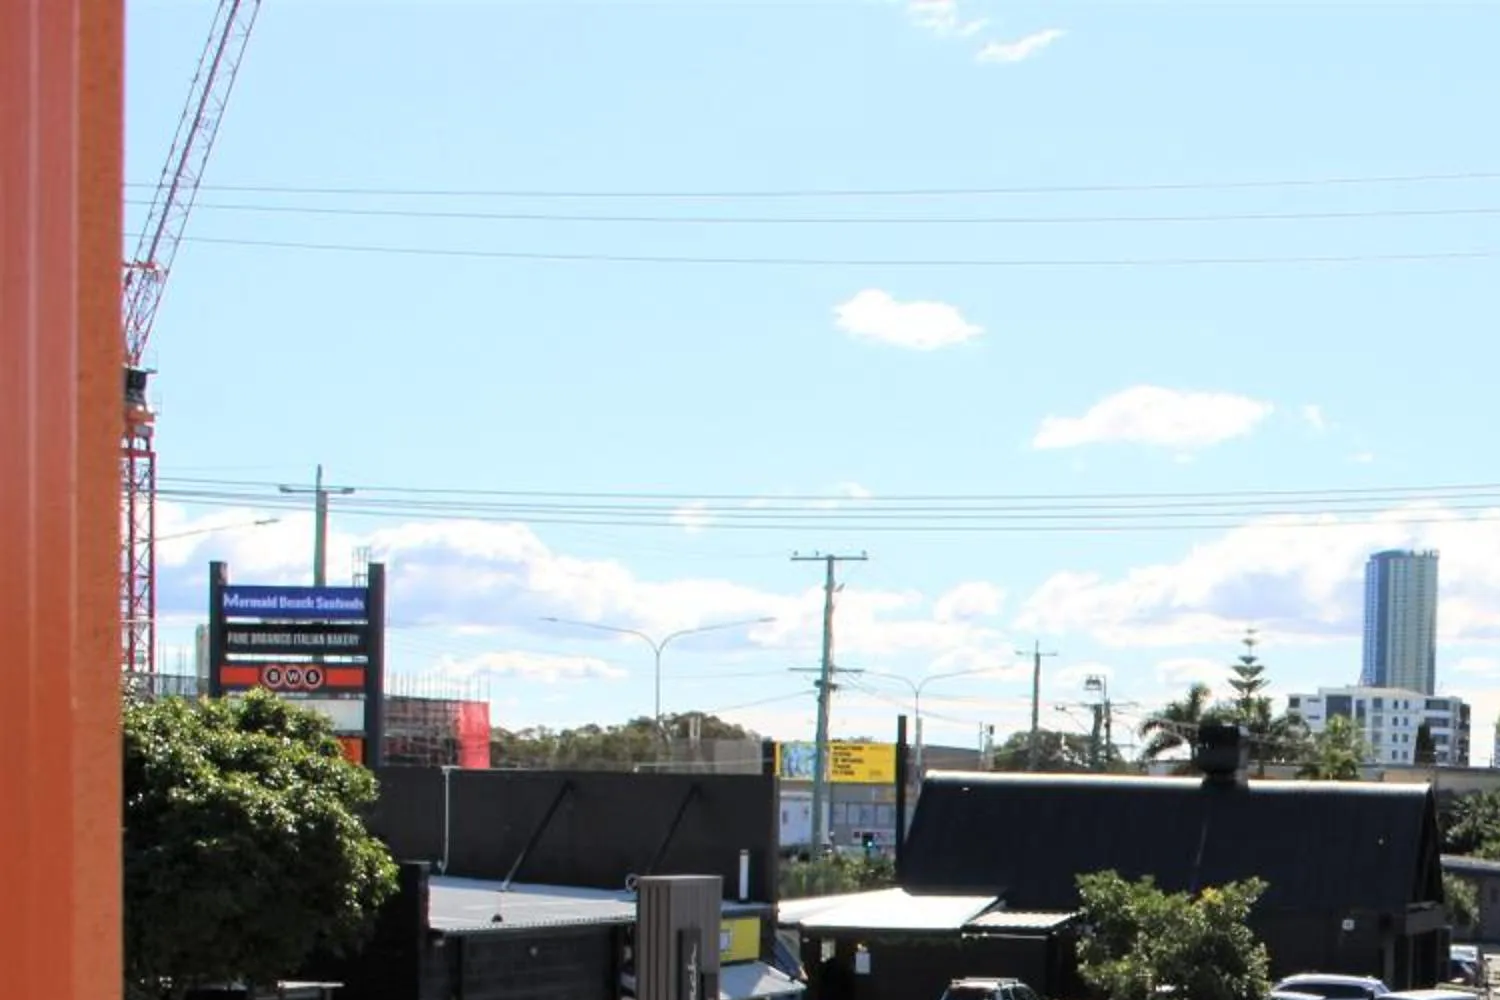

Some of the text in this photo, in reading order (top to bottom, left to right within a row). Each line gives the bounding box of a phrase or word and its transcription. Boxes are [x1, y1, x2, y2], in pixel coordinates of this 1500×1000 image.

[223, 592, 278, 609] Mermaid
[279, 596, 315, 609] Beach
[293, 633, 325, 646] ITALIAN
[327, 634, 360, 646] BAKERY
